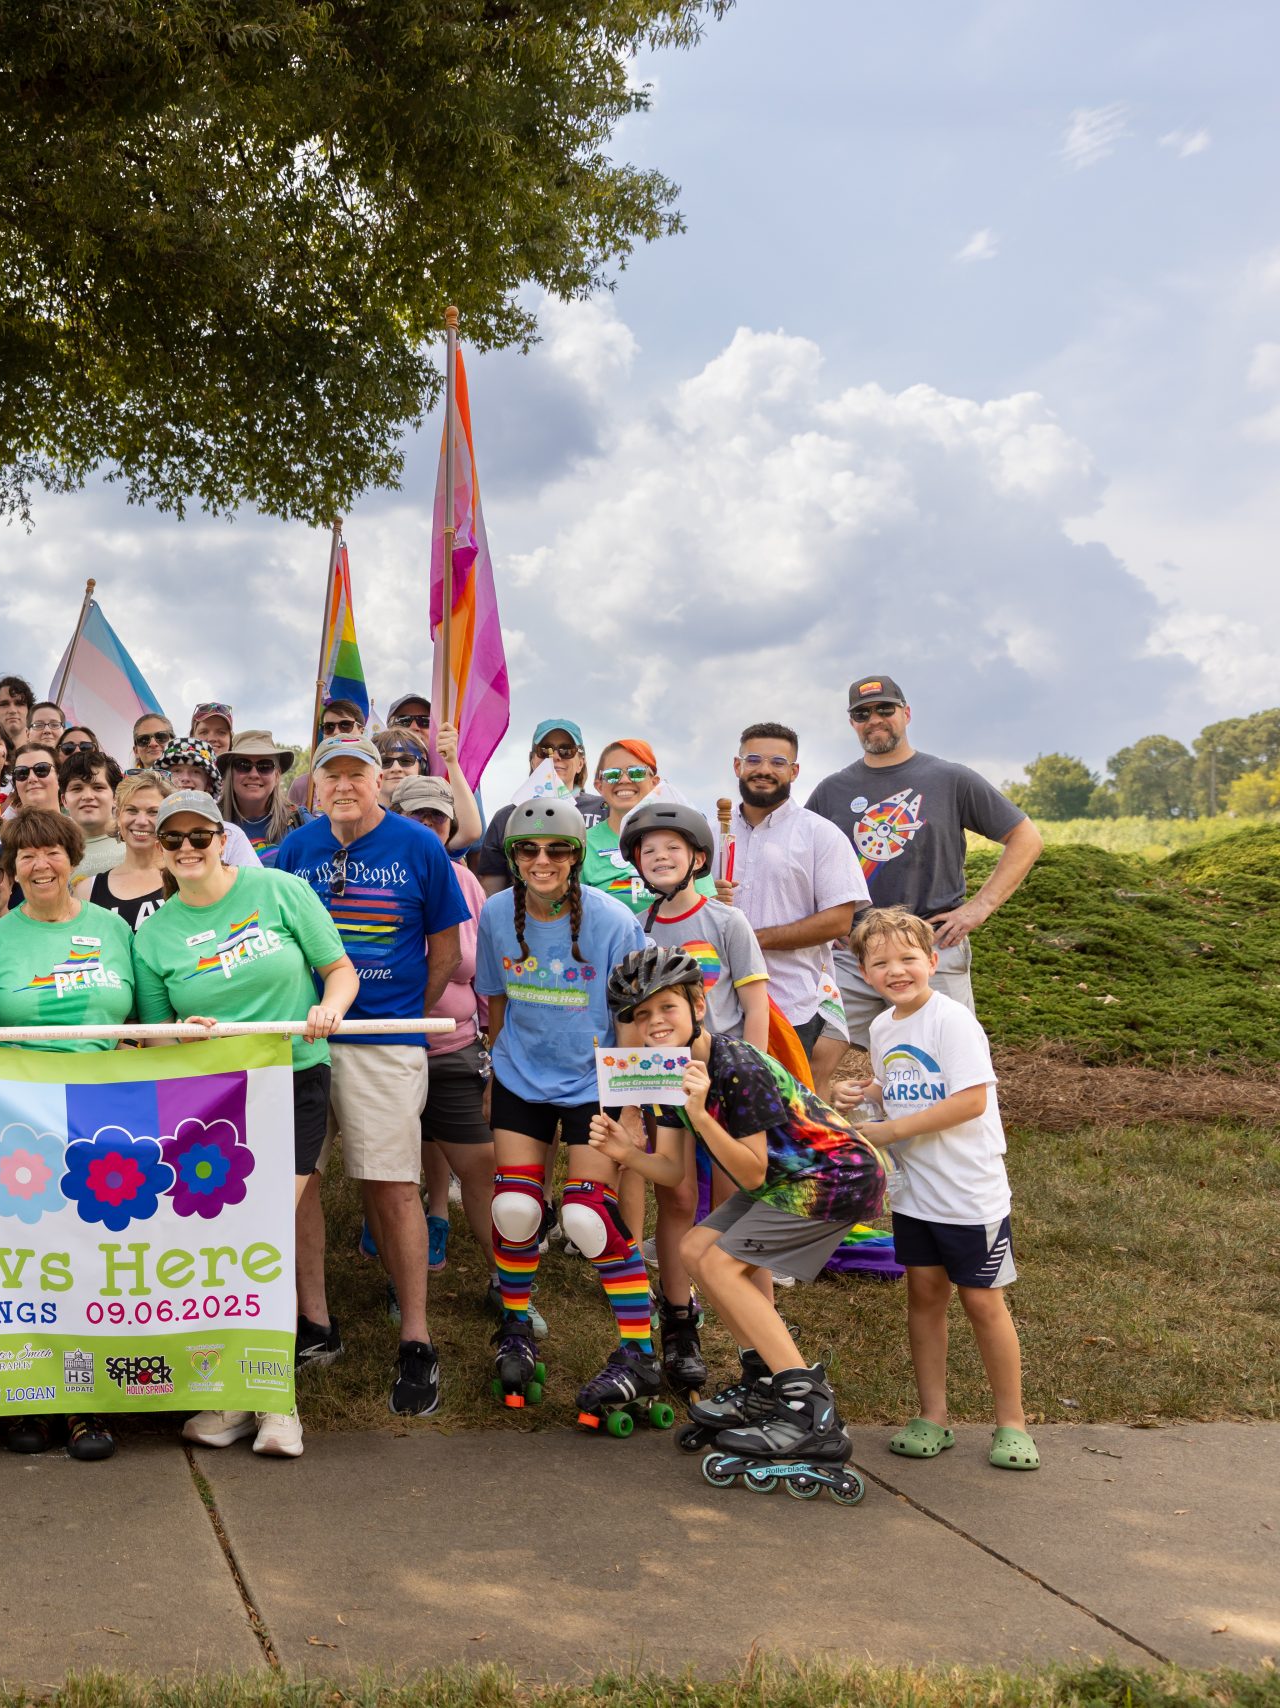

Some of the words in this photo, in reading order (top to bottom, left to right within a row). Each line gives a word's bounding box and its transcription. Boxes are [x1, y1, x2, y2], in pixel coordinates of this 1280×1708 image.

[345, 859, 410, 889] People
[218, 926, 281, 979] pride
[54, 962, 122, 999] pride
[74, 983, 95, 991] HOLLY
[98, 1241, 283, 1297] Here
[85, 1293, 262, 1327] 09.06.2025
[16, 1343, 54, 1360] Smith
[105, 1355, 165, 1372] SCHOOL
[238, 1359, 293, 1379] THRIVE
[6, 1386, 56, 1401] LOGAN
[126, 1385, 145, 1395] HOLLY
[145, 1384, 174, 1395] SPRINGS
[765, 1465, 809, 1475] Rollerblade
